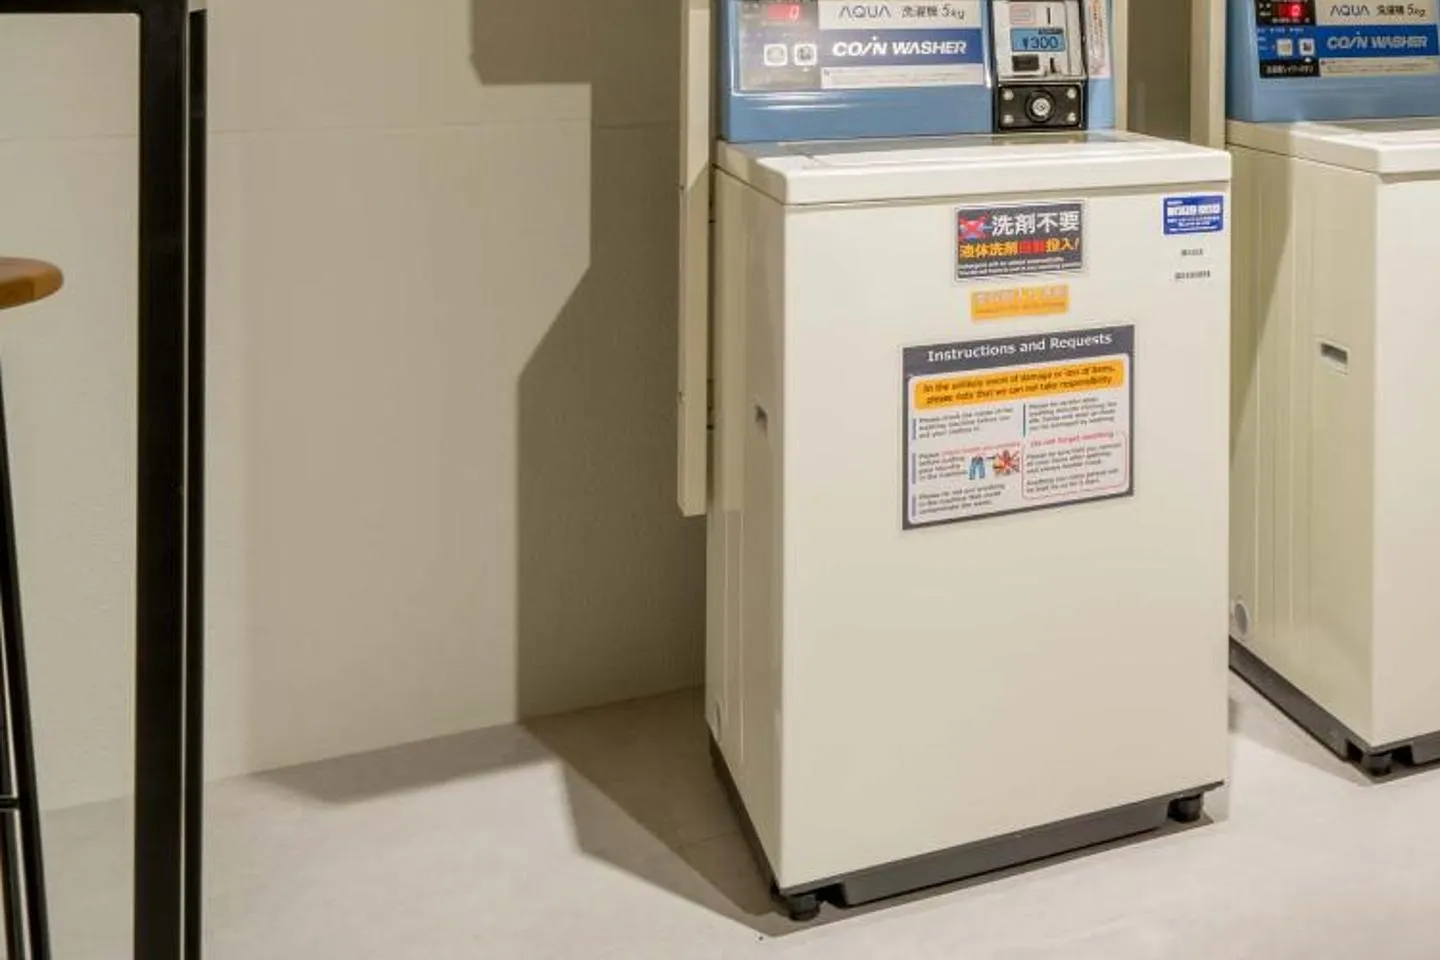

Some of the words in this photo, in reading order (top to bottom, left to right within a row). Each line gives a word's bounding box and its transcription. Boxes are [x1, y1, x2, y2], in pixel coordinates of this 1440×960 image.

[838, 4, 892, 19] AQUA
[1329, 3, 1370, 17] AQUA
[891, 40, 967, 56] WASHER
[1371, 35, 1428, 50] WASHER
[991, 210, 1080, 237] 洗剤不要
[927, 343, 1017, 362] Instructions
[1019, 338, 1046, 352] and
[1049, 333, 1113, 350] Requests
